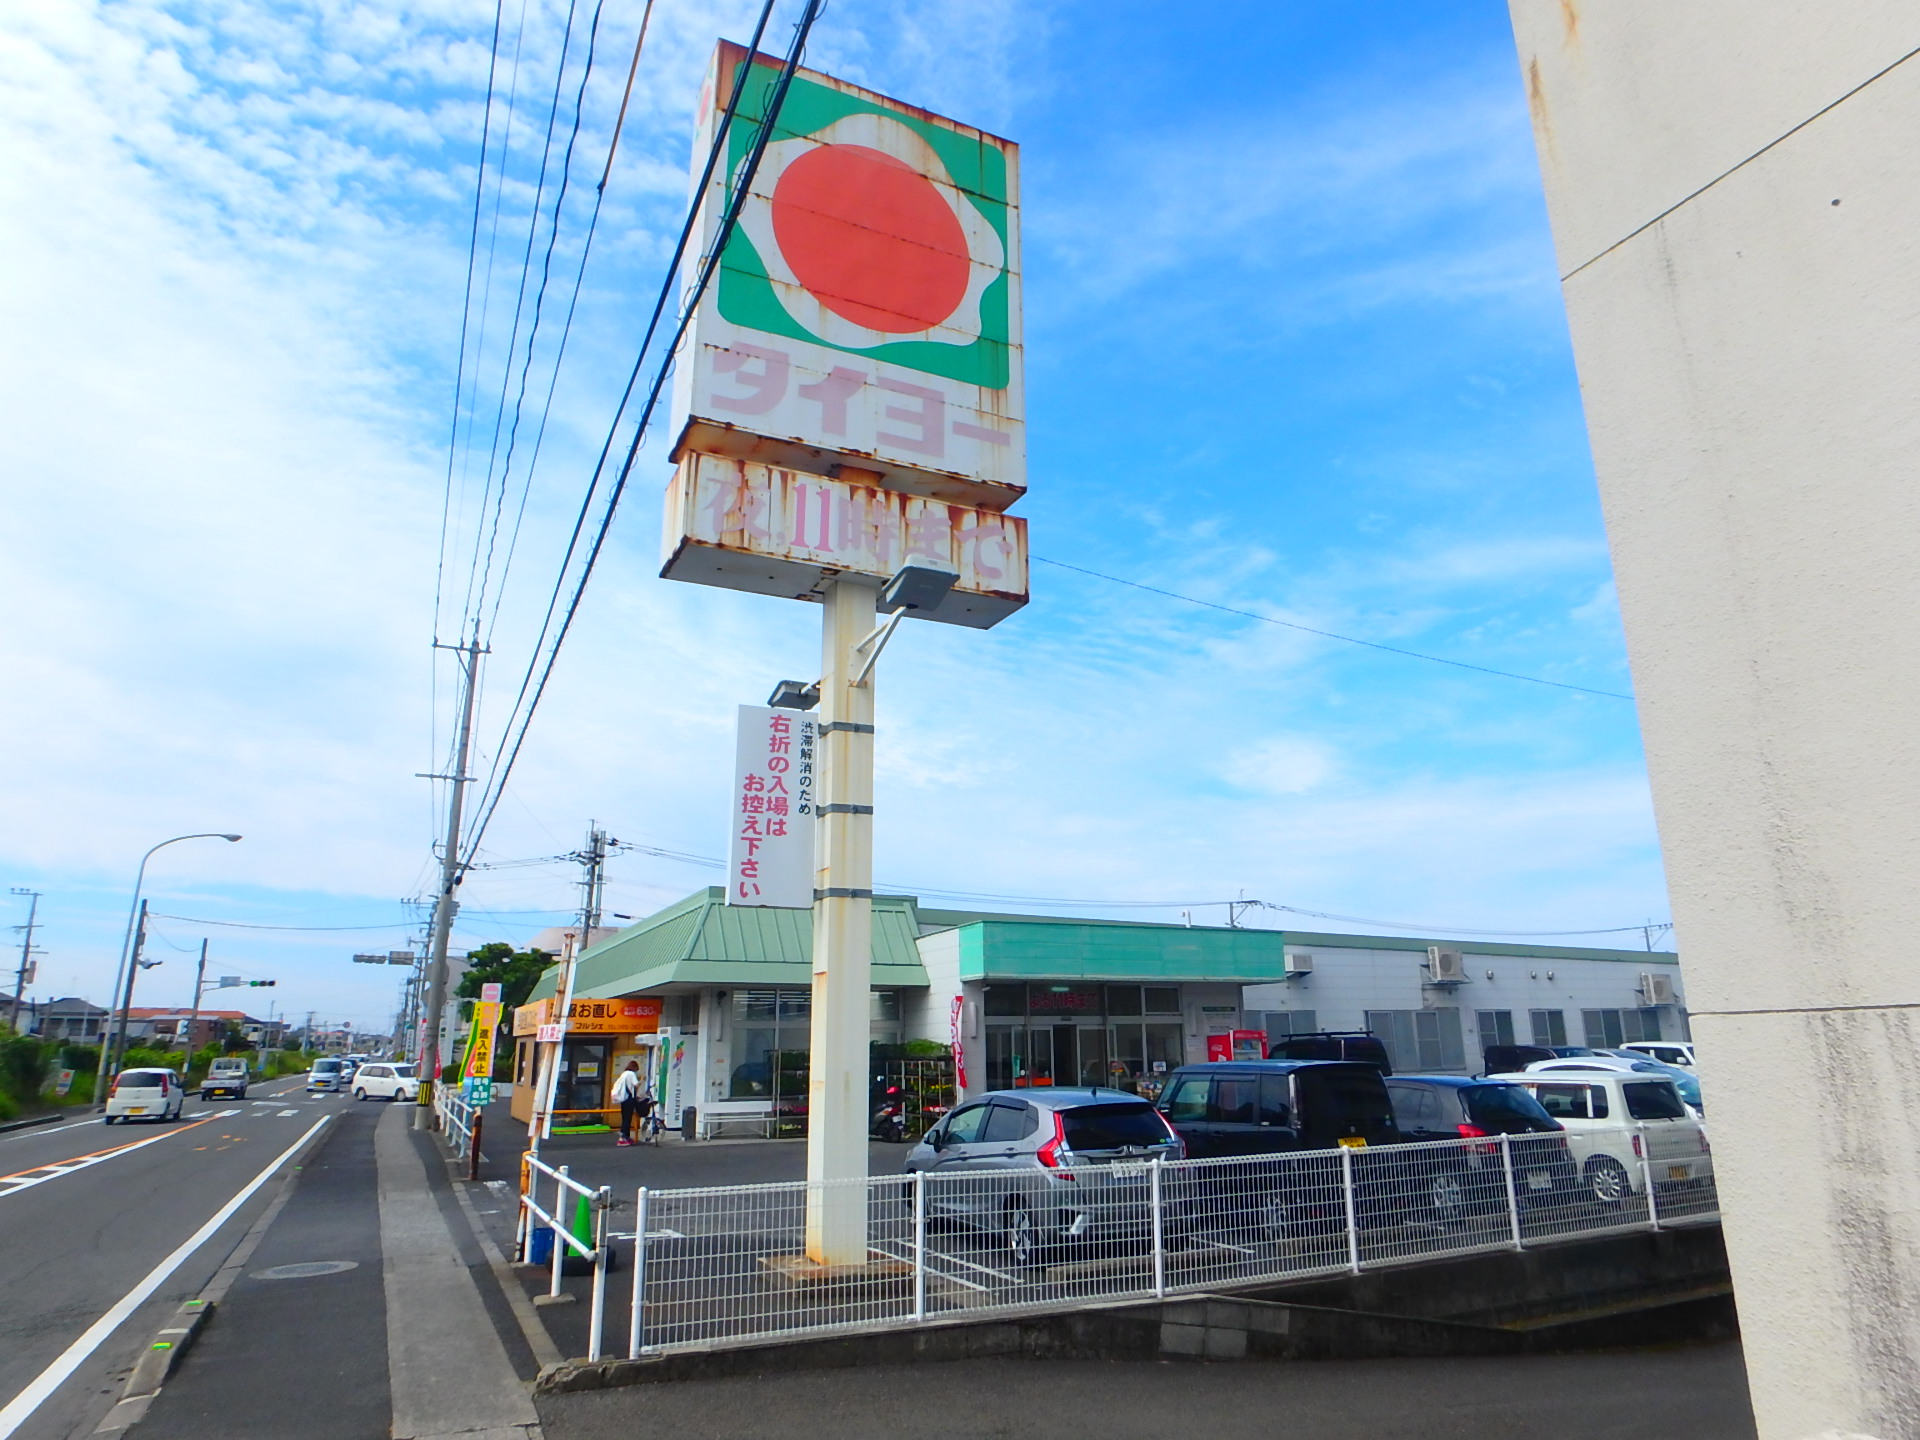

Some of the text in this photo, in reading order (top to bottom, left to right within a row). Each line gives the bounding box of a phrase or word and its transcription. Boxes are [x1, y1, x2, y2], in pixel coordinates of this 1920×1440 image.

[710, 340, 1011, 458] タイヨー
[765, 714, 792, 837] 右折の入場は
[798, 720, 814, 816] 渋滞解消のため
[738, 773, 765, 899] お控え下さい
[549, 1003, 618, 1019] 服お直し
